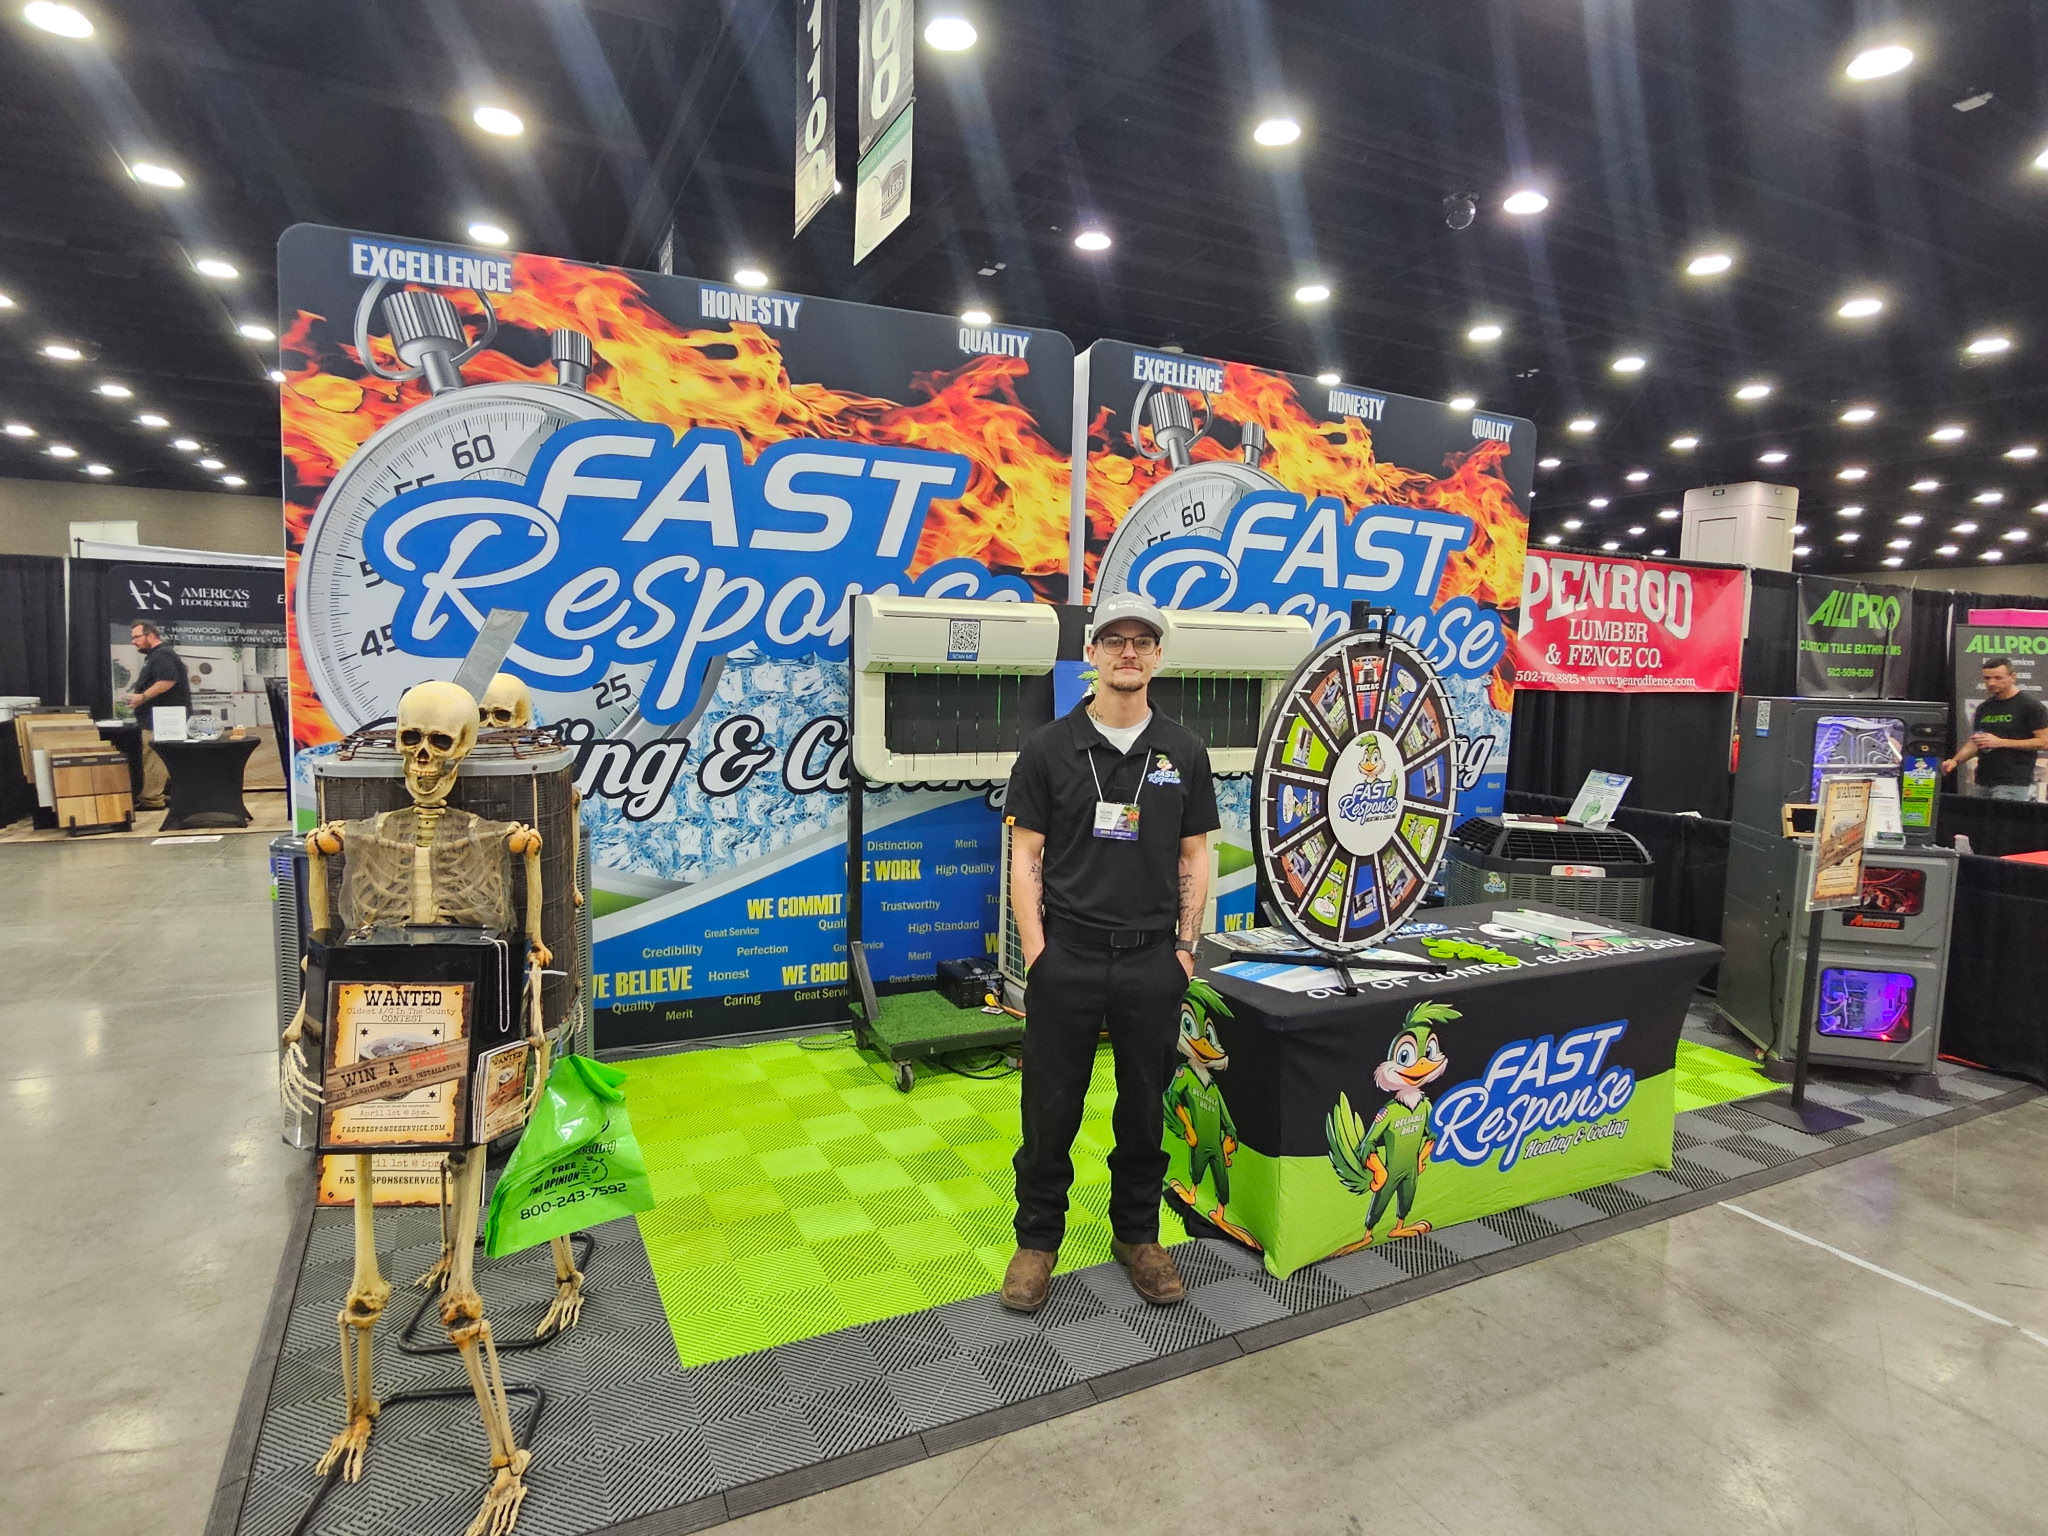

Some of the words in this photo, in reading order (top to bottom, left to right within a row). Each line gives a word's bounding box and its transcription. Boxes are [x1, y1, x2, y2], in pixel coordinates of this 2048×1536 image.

[352, 243, 512, 294] EXCELLENCE
[701, 288, 801, 330] HONESTY
[958, 327, 1030, 359] QUALITY
[1134, 355, 1224, 394] EXCELLENCE
[1328, 389, 1386, 421] HONESTY
[1472, 417, 1513, 443] QUALITY
[452, 434, 495, 470] 60
[530, 434, 957, 558] FAST
[1181, 501, 1206, 528] 60
[1218, 501, 1470, 597] FAST
[180, 587, 250, 600] AMERICA'S
[180, 598, 213, 607] FLOOR
[214, 599, 250, 609] SOURCE
[1517, 555, 1693, 641] PENROD
[1807, 590, 1901, 630] ALLPRO
[171, 626, 221, 635] HARDWOOD
[227, 628, 258, 636] LUXURY
[211, 635, 239, 643] SHEET
[241, 636, 266, 644] VINYL
[1568, 618, 1648, 643] LUMBER
[1830, 643, 1853, 654] TILE
[1965, 634, 2048, 655] ALLPRO
[1545, 643, 1561, 666] &
[1566, 644, 1632, 668] FENCE
[1635, 648, 1663, 669] CO.
[1588, 674, 1696, 688] www.penrodfence.com
[592, 673, 632, 711] 25
[700, 716, 776, 797] &
[1155, 770, 1175, 778] FAST
[1353, 782, 1392, 801] FAST
[1338, 796, 1398, 825] Response
[867, 841, 923, 852] Distinction
[955, 839, 978, 849] Merit
[875, 859, 922, 882] WORK
[935, 864, 958, 877] High
[960, 863, 995, 876] Quality
[747, 898, 774, 921] WE
[777, 893, 843, 918] COMMIT
[881, 900, 941, 912] Trustworthy
[704, 929, 728, 939] Great
[729, 926, 760, 937] Service
[818, 919, 847, 931] Quali
[908, 922, 932, 935] High
[934, 920, 980, 932] Standard
[1224, 913, 1243, 932] WE
[642, 944, 703, 959] Credibility
[736, 945, 789, 957] Perfection
[908, 951, 932, 961] Merit
[1370, 977, 1410, 990] OF
[1536, 944, 1645, 968] ELECTRIC
[1649, 937, 1695, 950] BILL
[615, 965, 693, 998] BELIEVE
[708, 968, 750, 982] Honest
[782, 964, 808, 987] WE
[889, 974, 911, 985] Great
[364, 990, 442, 1007] WANTED
[723, 994, 762, 1008] Caring
[794, 990, 821, 1002] Great
[381, 1014, 423, 1023] CONTEST
[425, 1008, 456, 1017] County
[612, 1000, 657, 1015] Quality
[665, 1009, 694, 1022] Merit
[491, 1051, 523, 1066] WANTED
[1482, 1025, 1623, 1096] FAST
[341, 1067, 378, 1088] WIN
[388, 1061, 400, 1077] A
[350, 1080, 393, 1097] CONDITIONER
[395, 1074, 413, 1085] WITH
[415, 1062, 462, 1081] INSTALLATION
[359, 1109, 385, 1118] April
[1434, 1071, 1633, 1166] Response
[341, 1123, 447, 1134] FASTRESPONSESERVICE.COM
[1522, 1133, 1572, 1160] Heating
[1573, 1130, 1585, 1147] &
[1585, 1118, 1629, 1143] Cooling
[392, 1159, 409, 1168] 1st
[551, 1161, 577, 1175] FREE
[543, 1171, 581, 1190] OPINION
[520, 1182, 628, 1220] 800-243-7592
